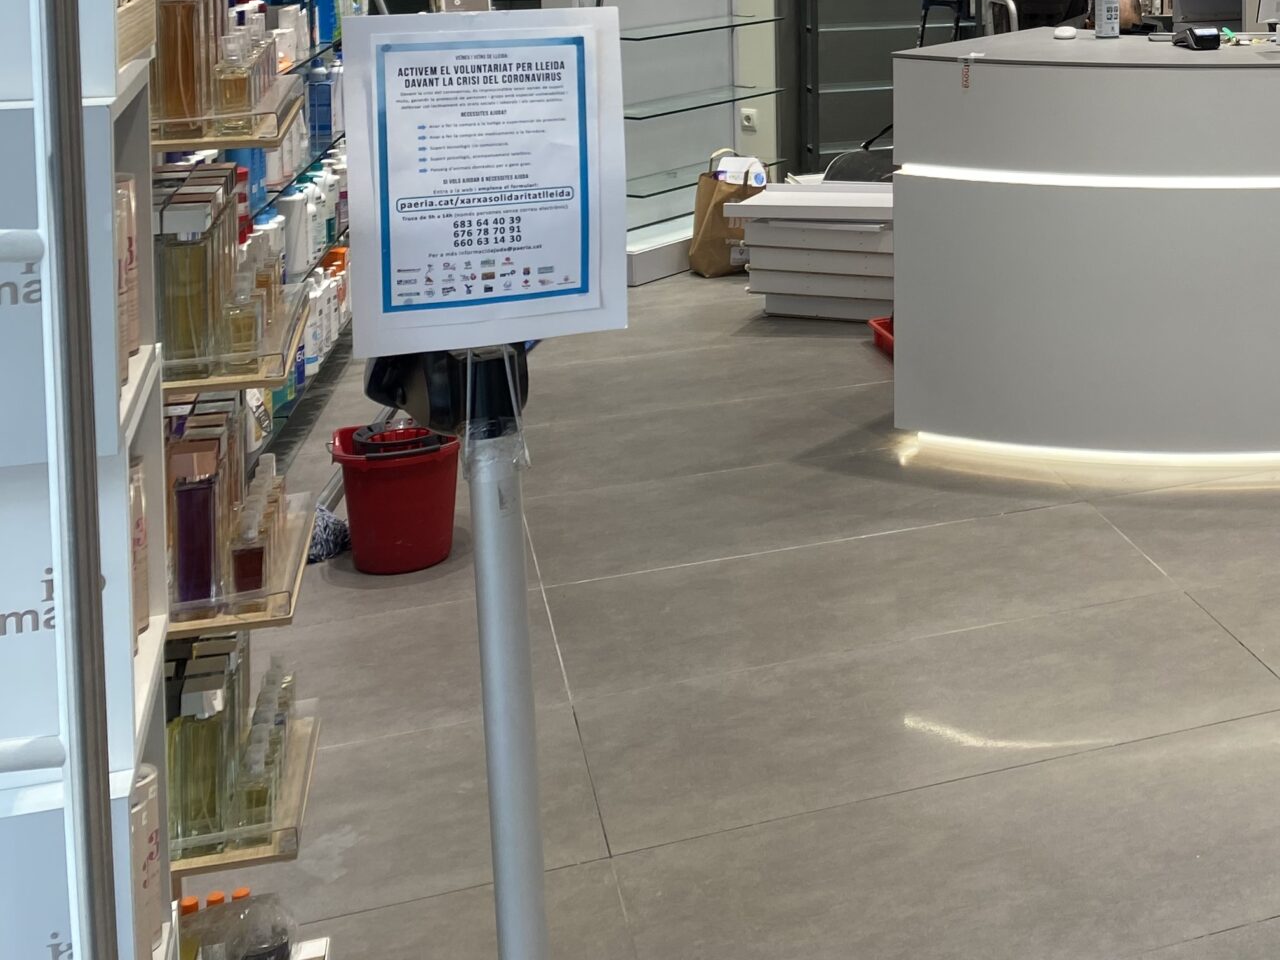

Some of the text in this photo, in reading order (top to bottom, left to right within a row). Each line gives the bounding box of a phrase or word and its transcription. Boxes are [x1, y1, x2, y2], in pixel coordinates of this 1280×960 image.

[398, 60, 565, 77] ACTIVEM EL VOLUNTARIAT PER LLEIDA
[405, 72, 562, 88] DAVANT LA CRISI DEL CORONAVIRUS
[400, 189, 571, 210] paeria.cat/xarxasolidaritatlleida
[453, 215, 521, 229] 683 64 40 39
[453, 225, 521, 238] 676 78 70 91
[453, 234, 522, 248] 660 63 14 30
